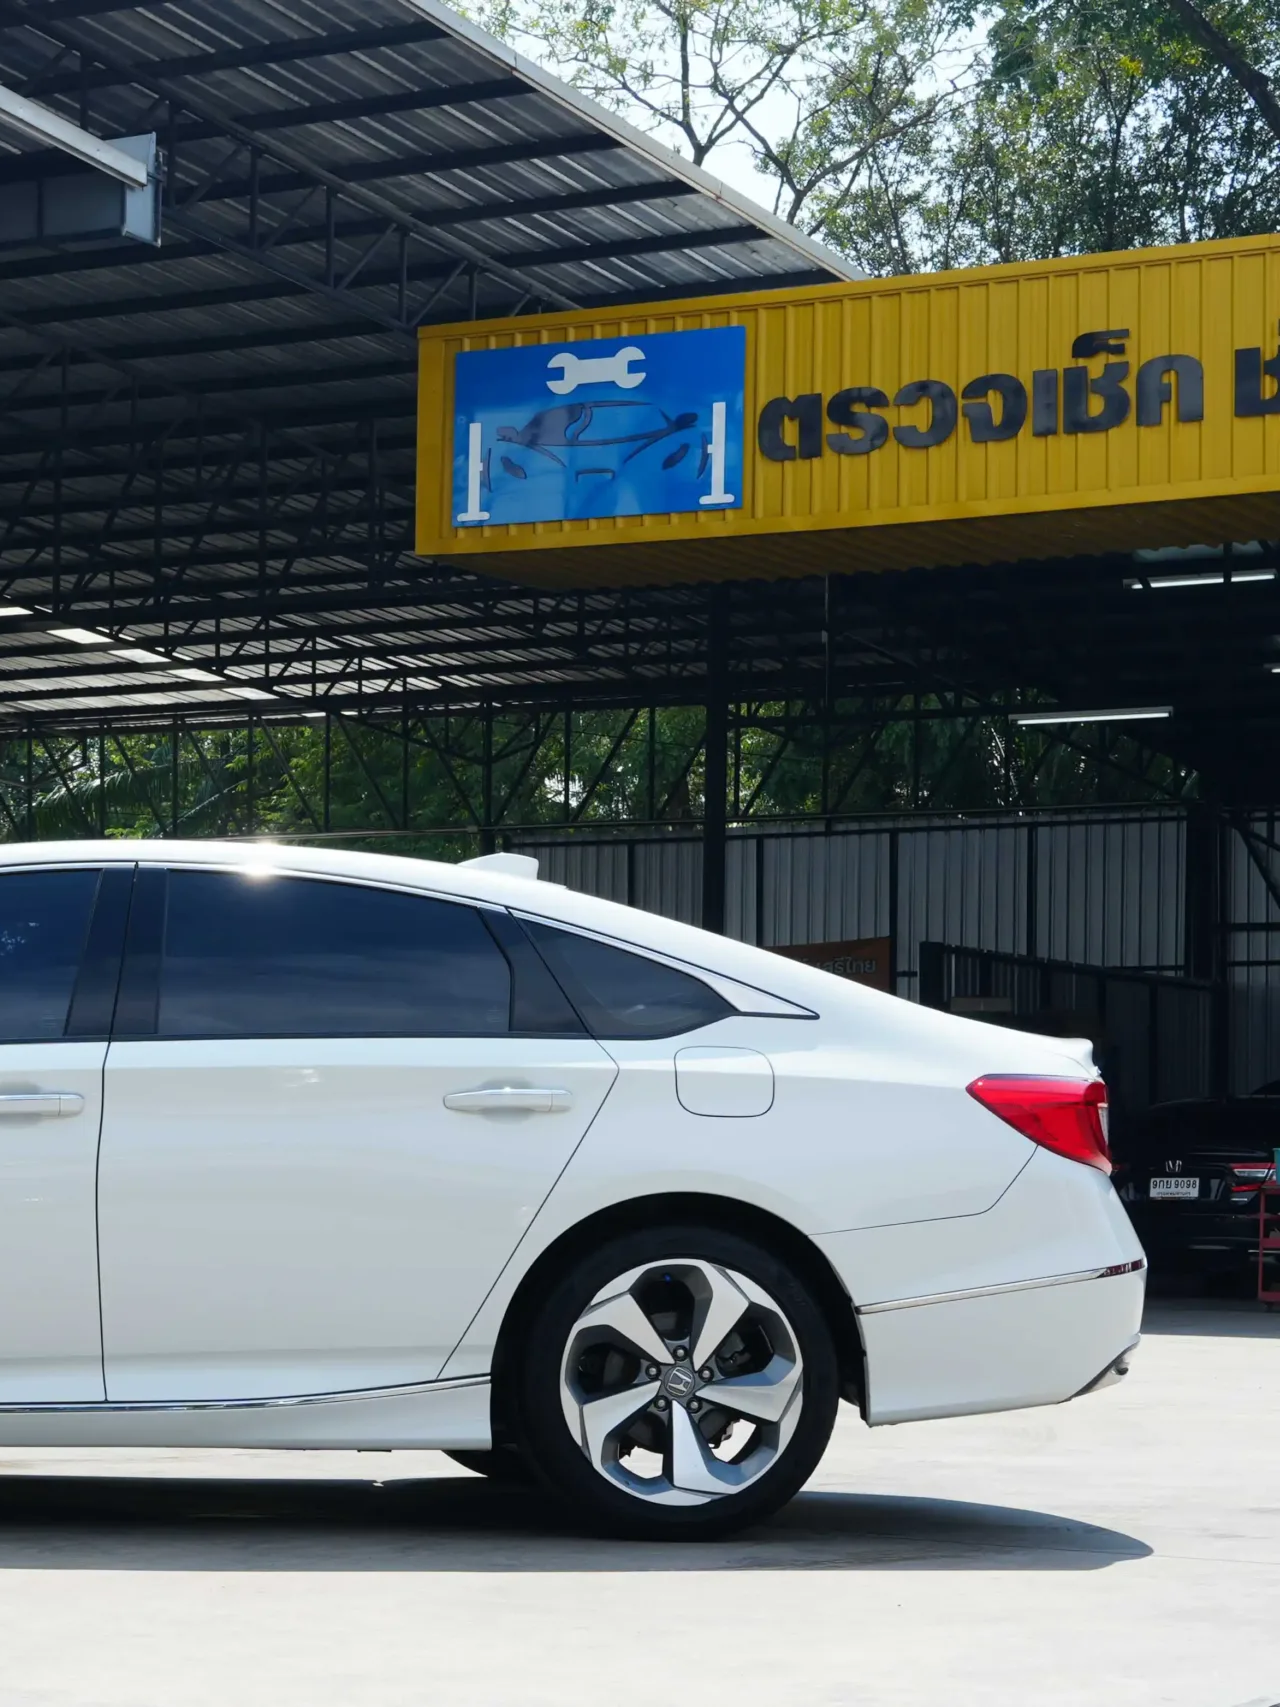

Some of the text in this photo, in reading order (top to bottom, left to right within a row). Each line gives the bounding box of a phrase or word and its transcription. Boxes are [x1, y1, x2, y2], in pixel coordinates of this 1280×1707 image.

[758, 329, 1204, 462] ตรวจเช็ค
[1174, 1179, 1197, 1189] 9098
